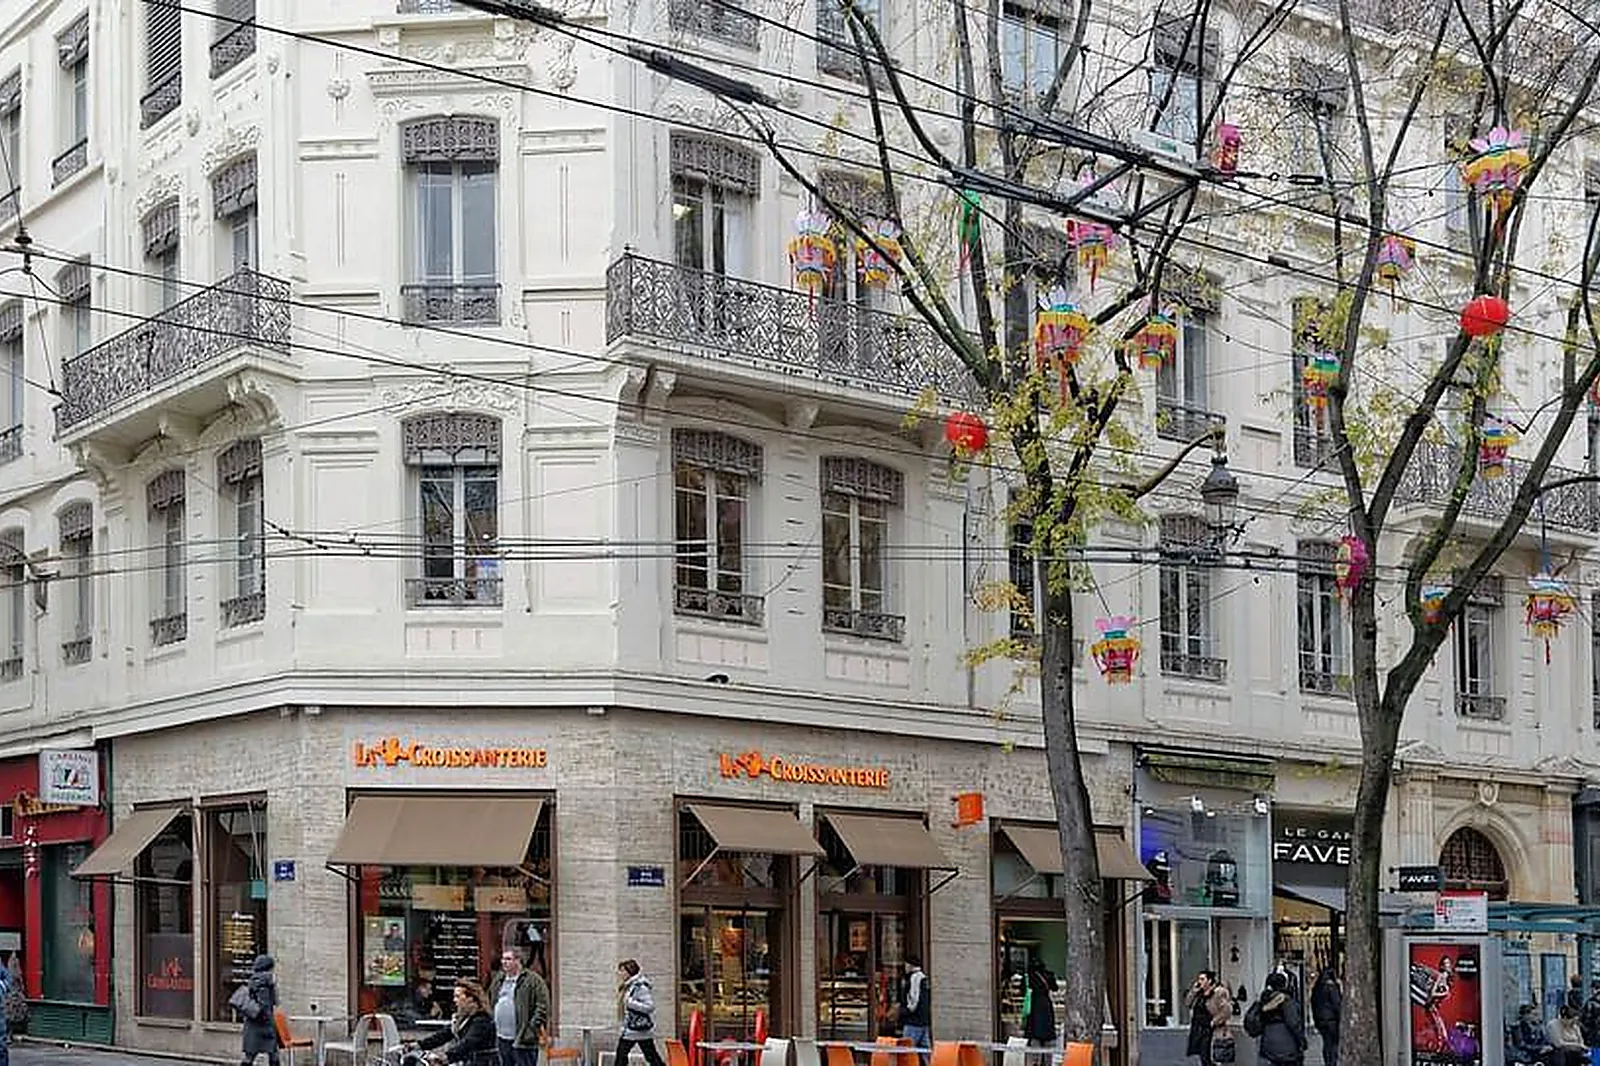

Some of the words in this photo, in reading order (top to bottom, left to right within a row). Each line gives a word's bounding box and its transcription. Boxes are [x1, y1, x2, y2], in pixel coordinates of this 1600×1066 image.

[409, 741, 548, 767] CROISSANTERIE
[770, 756, 889, 787] CROISSANTERIE
[1284, 826, 1308, 838] LE
[1317, 829, 1352, 841] GAR
[1273, 842, 1351, 865] FAVE
